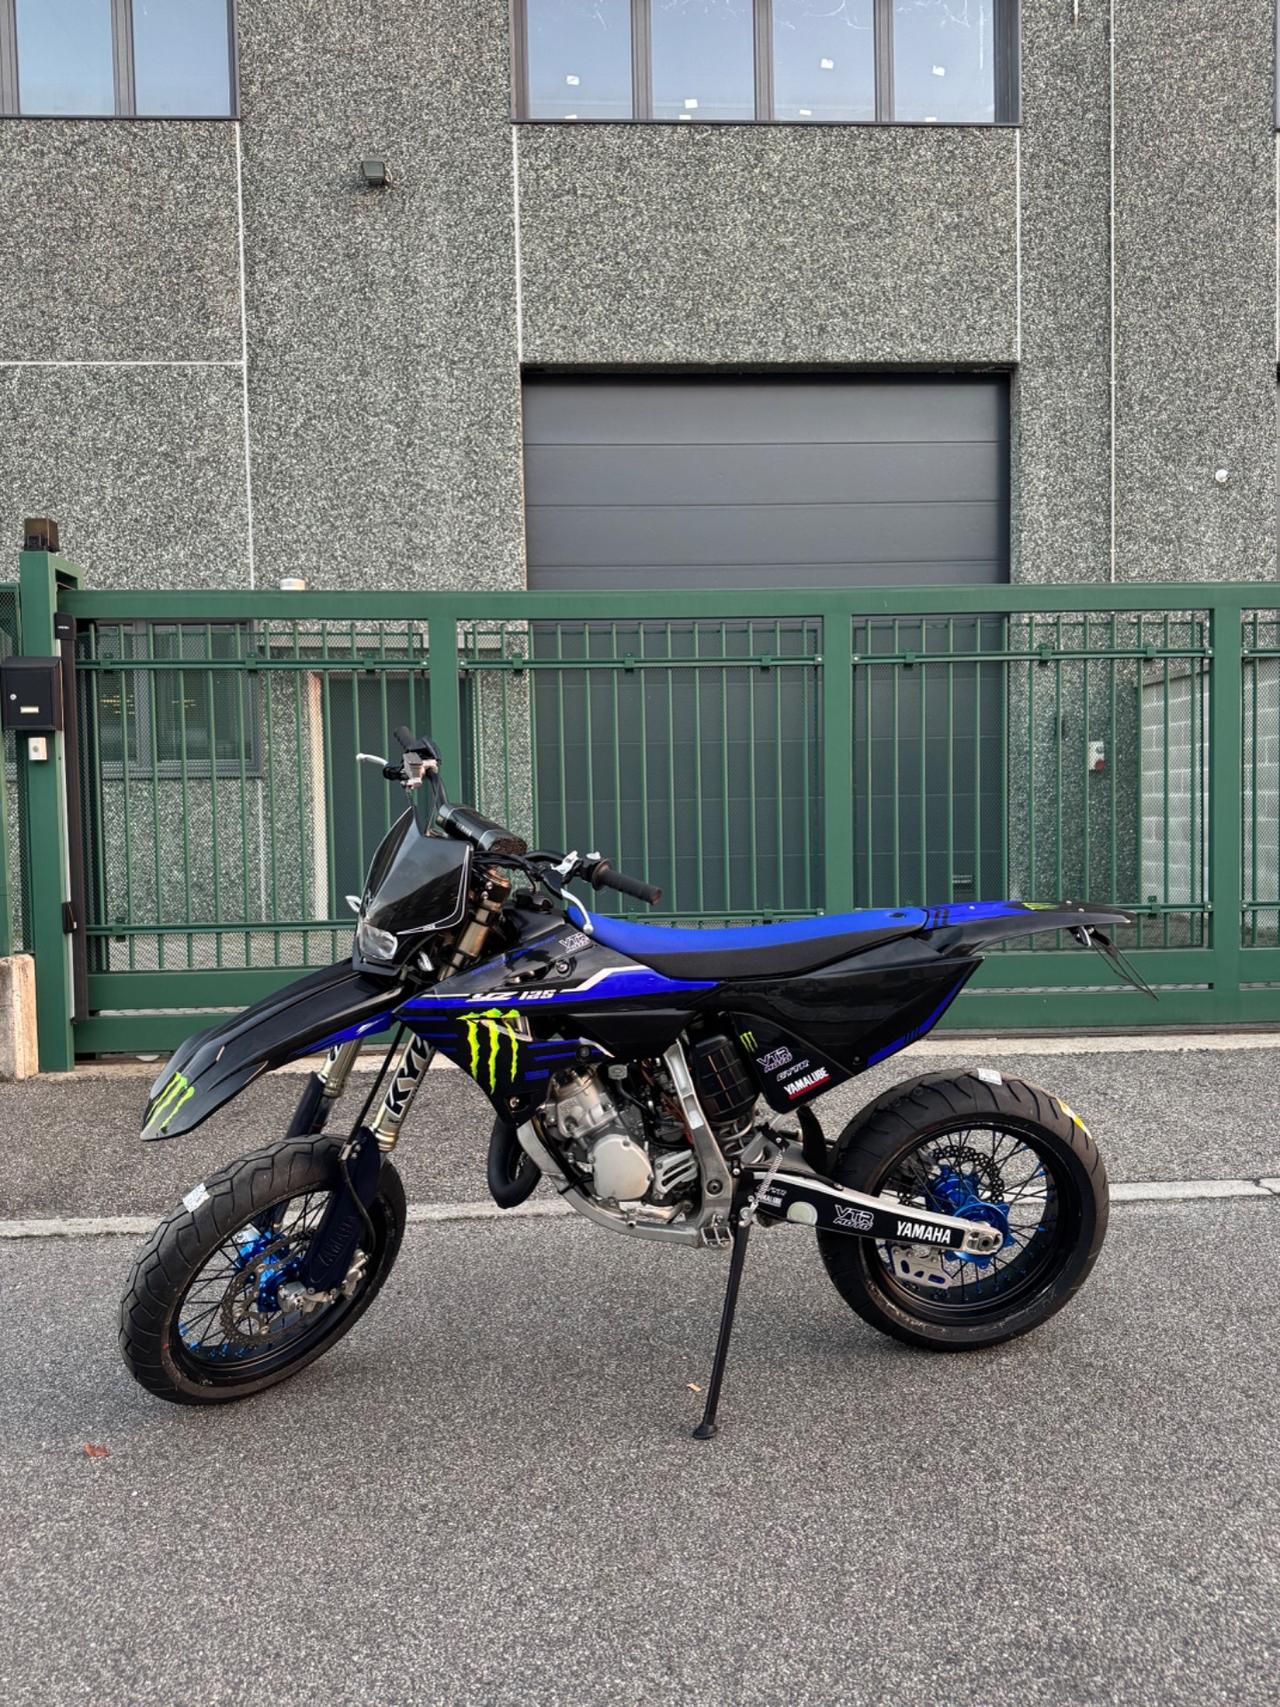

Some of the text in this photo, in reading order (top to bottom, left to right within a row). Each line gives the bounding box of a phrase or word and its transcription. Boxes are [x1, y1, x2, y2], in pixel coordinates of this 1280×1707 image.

[783, 1066, 830, 1096] YAMALUBE
[834, 1204, 874, 1224] VTR
[897, 1220, 952, 1244] YAMAHA
